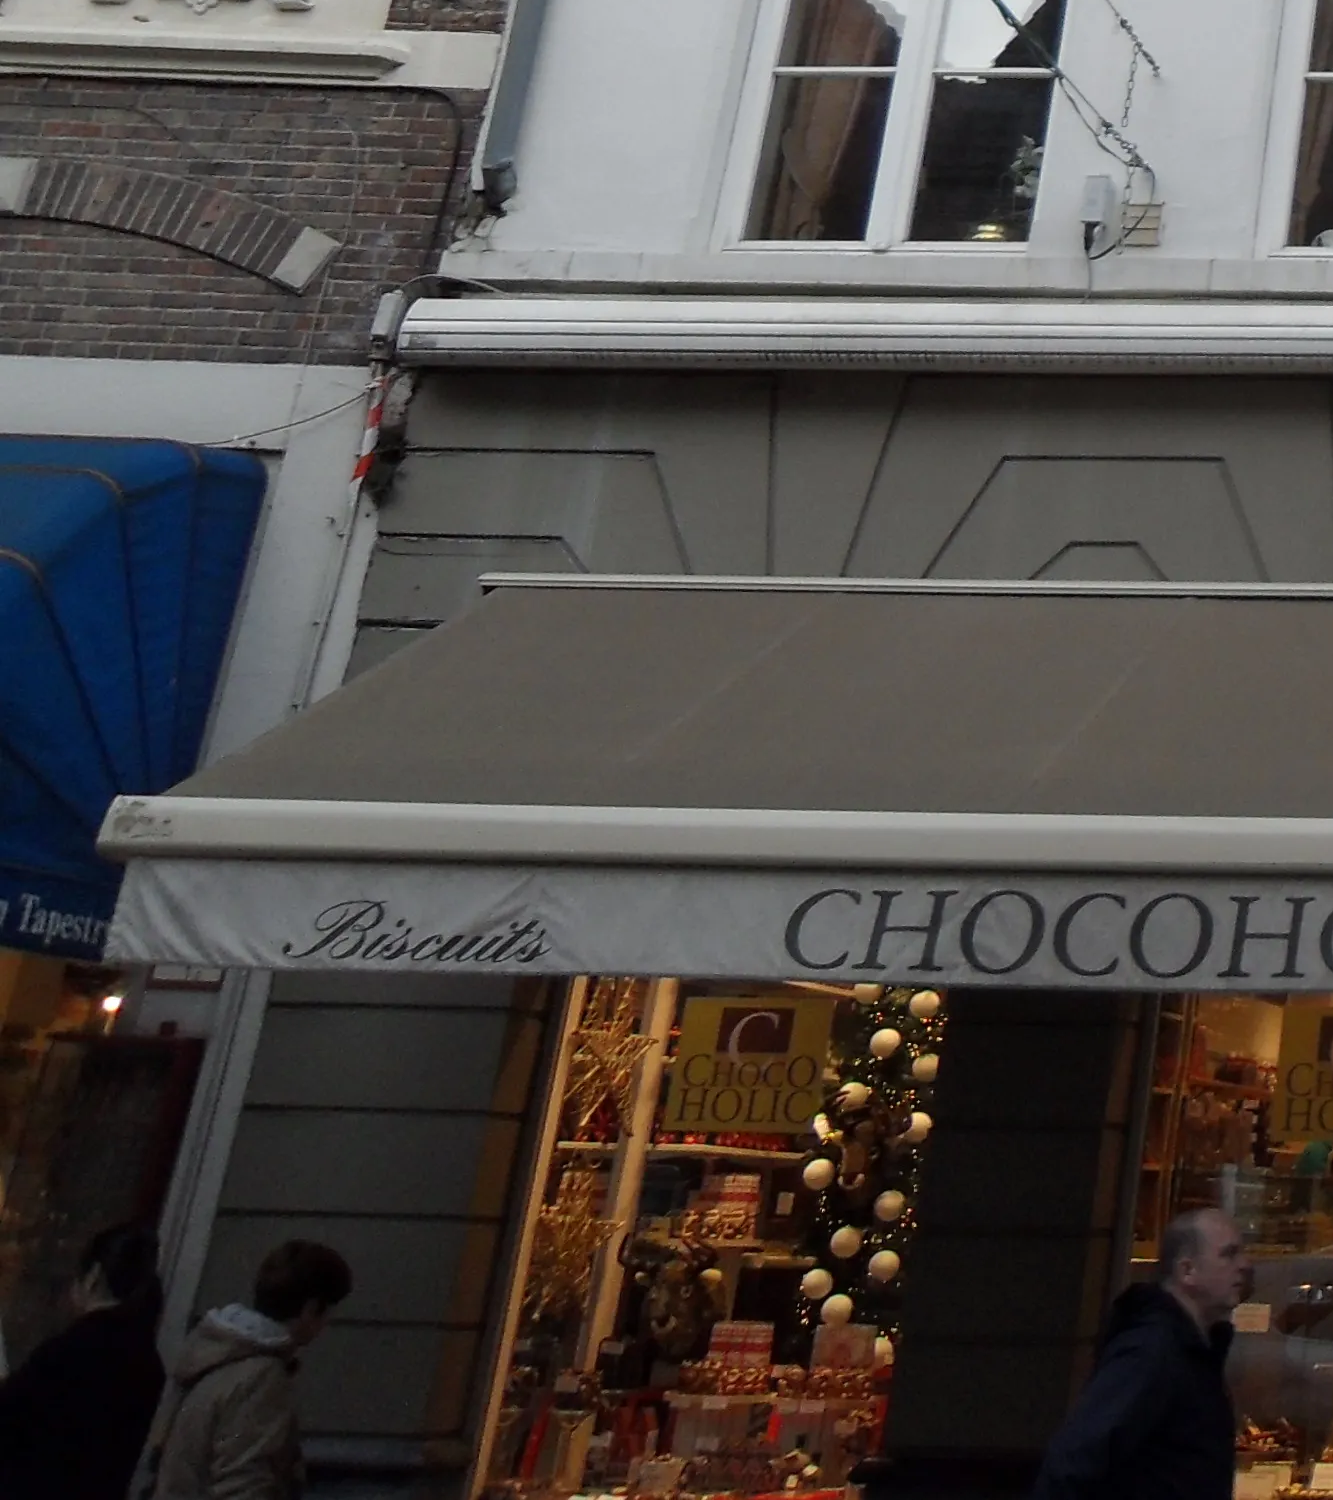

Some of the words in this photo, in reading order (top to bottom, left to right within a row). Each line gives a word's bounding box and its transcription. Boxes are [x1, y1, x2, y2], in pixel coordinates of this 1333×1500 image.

[17, 892, 108, 947] Tapestr
[281, 899, 552, 964] Biscuits
[683, 1053, 817, 1089] CHOCO
[673, 1087, 815, 1124] HOLIC
